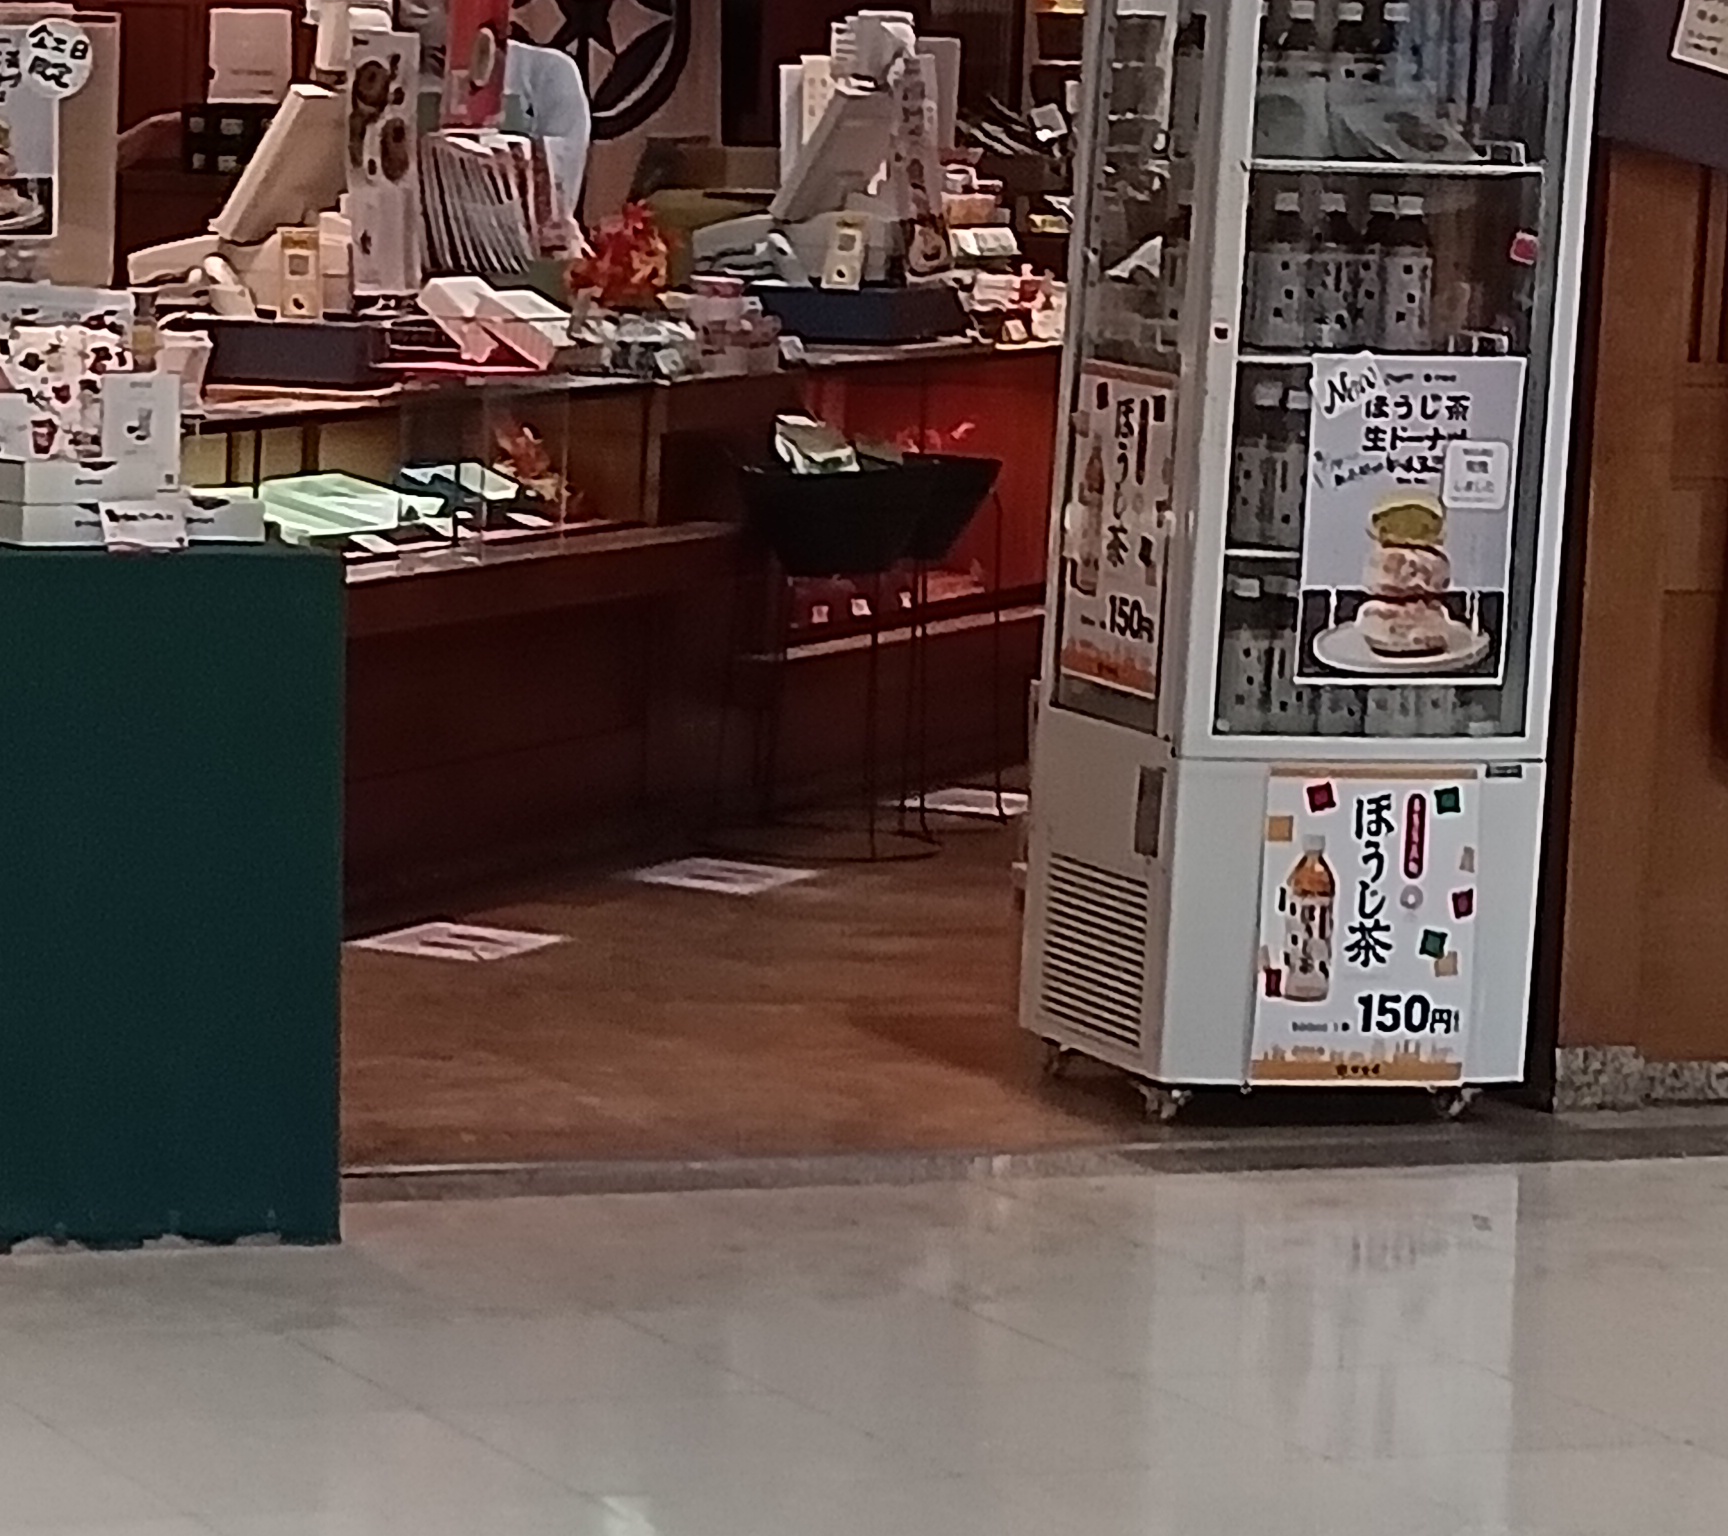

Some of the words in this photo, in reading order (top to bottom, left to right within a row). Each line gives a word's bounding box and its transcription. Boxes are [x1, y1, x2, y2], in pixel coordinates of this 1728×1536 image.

[1364, 394, 1471, 421] ほうじ茶
[1344, 793, 1395, 968] ほうじ茶
[1357, 993, 1452, 1034] 150円
